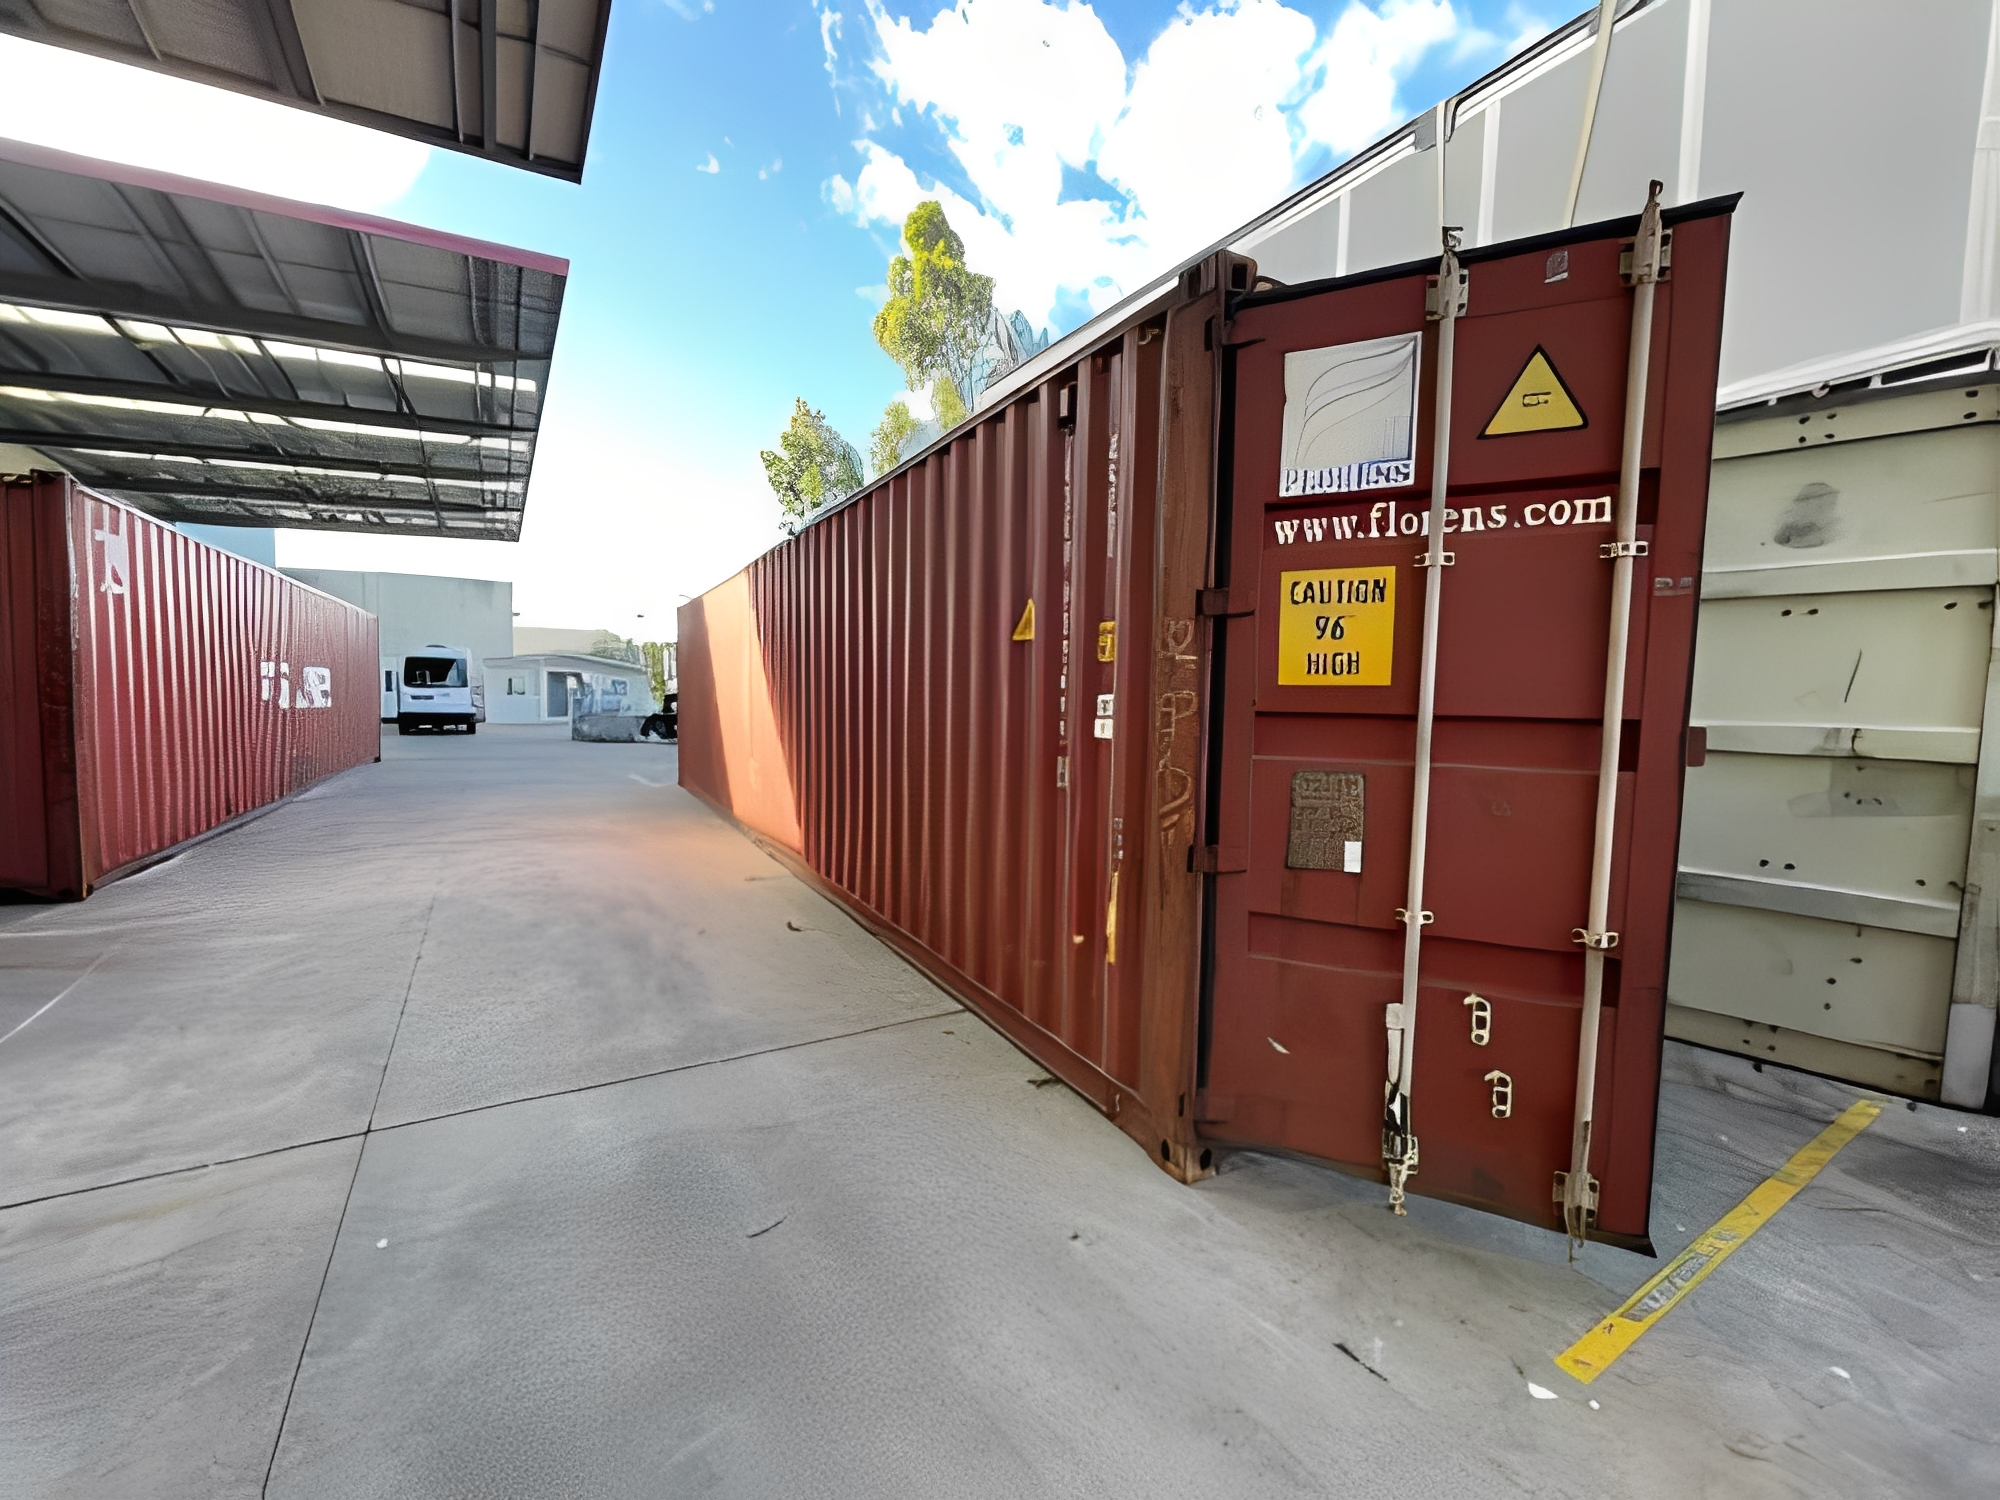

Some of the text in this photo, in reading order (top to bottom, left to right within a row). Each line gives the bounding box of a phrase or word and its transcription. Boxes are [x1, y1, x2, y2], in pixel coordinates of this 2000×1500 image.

[1290, 577, 1387, 605] CAUTION
[1315, 614, 1345, 640] 96
[1306, 651, 1360, 676] HIGH
